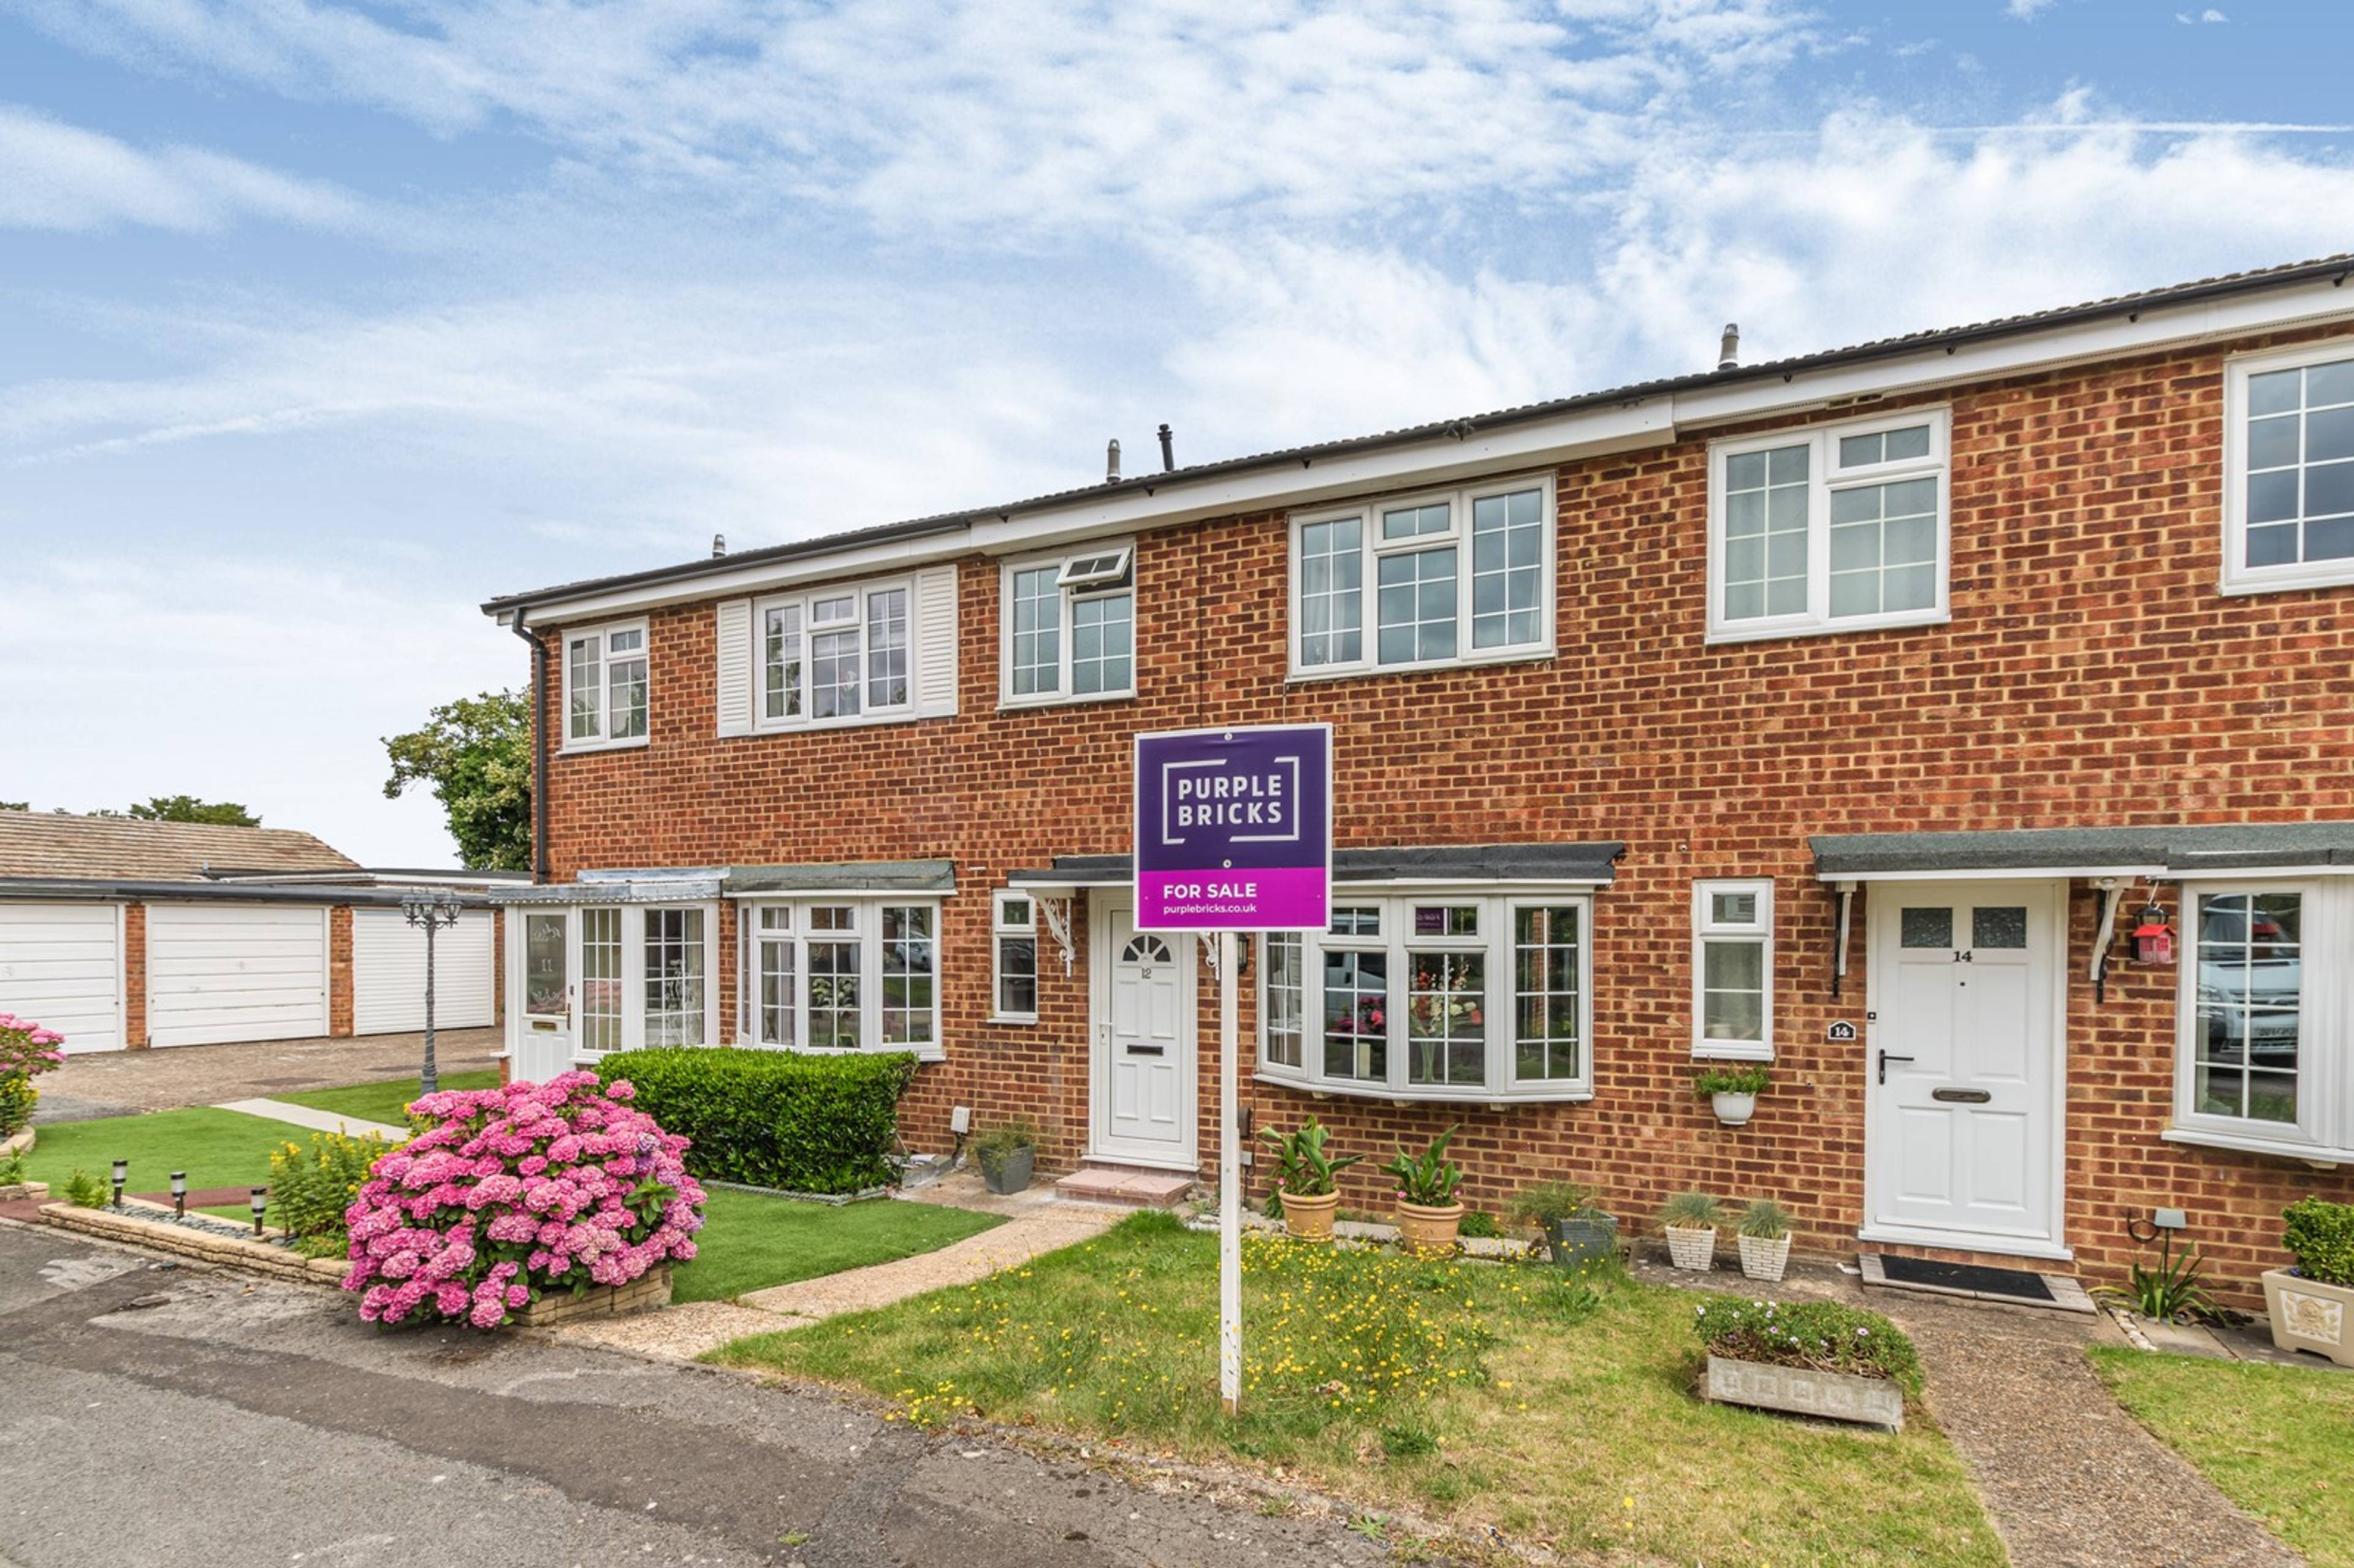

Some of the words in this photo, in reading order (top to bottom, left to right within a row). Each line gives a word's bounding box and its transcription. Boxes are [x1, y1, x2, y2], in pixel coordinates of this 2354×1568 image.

[1178, 774, 1281, 800] PURPLE
[1178, 802, 1282, 826] BRICKS
[1164, 885, 1201, 899] FOR
[1207, 883, 1257, 898] SALE
[1164, 904, 1257, 915] purplebricks.co.uk
[1952, 950, 1973, 962] 14
[541, 958, 552, 972] 11
[1141, 968, 1151, 979] 12
[1835, 1027, 1850, 1037] 14
